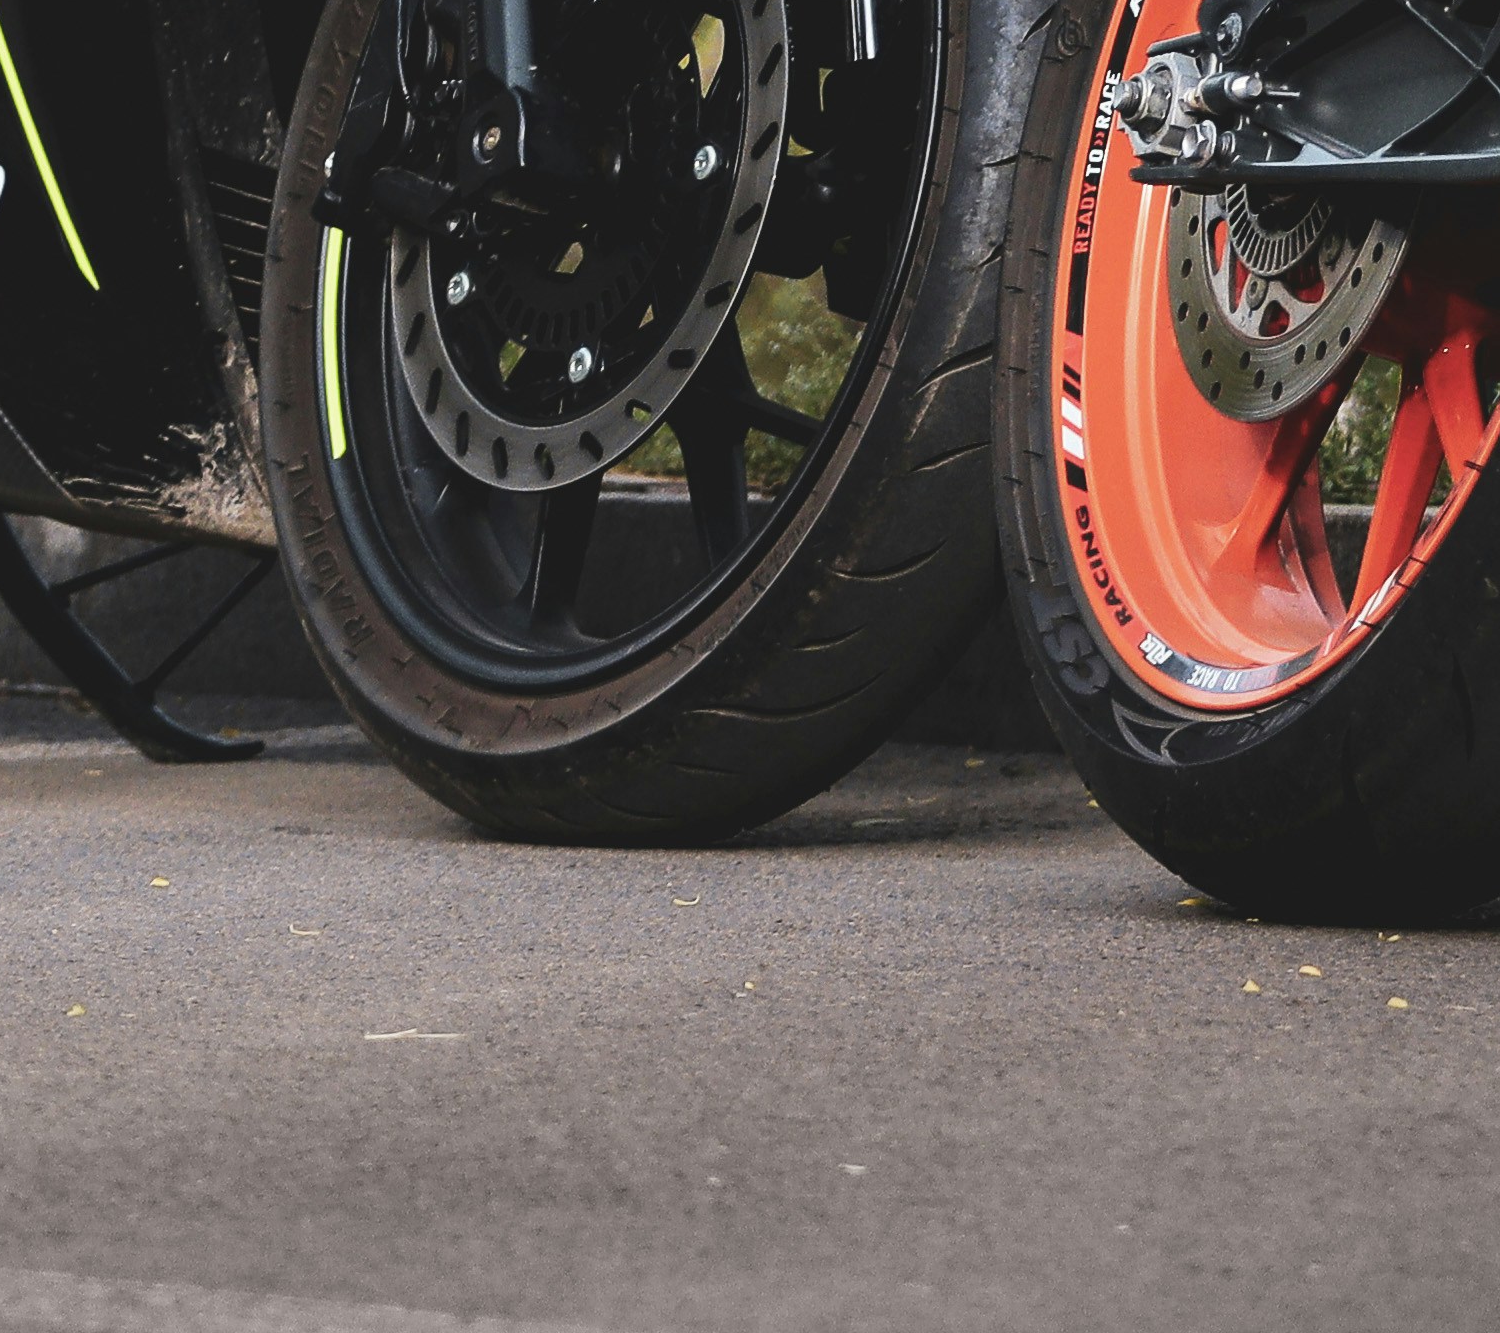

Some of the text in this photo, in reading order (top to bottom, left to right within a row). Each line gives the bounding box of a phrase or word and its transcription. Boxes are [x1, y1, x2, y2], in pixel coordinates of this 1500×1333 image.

[1073, 69, 1122, 255] READY TO RACE
[1074, 503, 1134, 628] RACING
